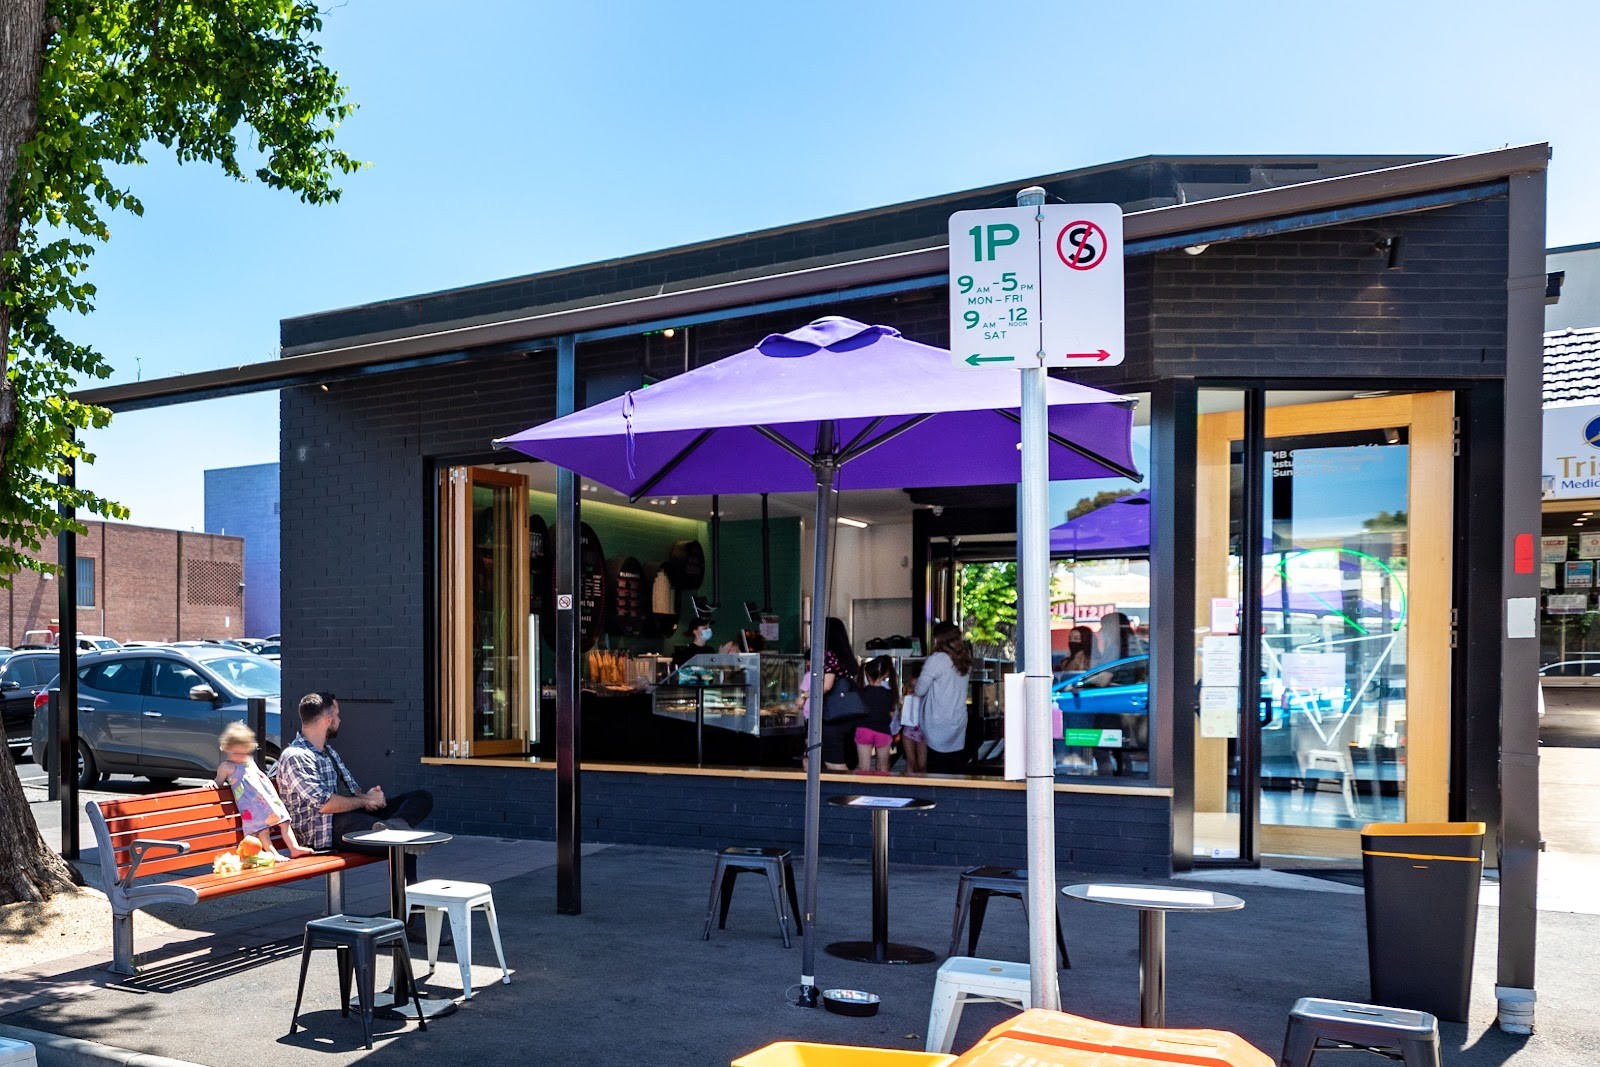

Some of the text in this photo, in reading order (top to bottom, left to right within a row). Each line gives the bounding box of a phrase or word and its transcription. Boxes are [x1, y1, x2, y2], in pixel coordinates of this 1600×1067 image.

[969, 223, 1020, 262] 1P
[984, 331, 1007, 340] SAT
[1556, 455, 1600, 478] Tri
